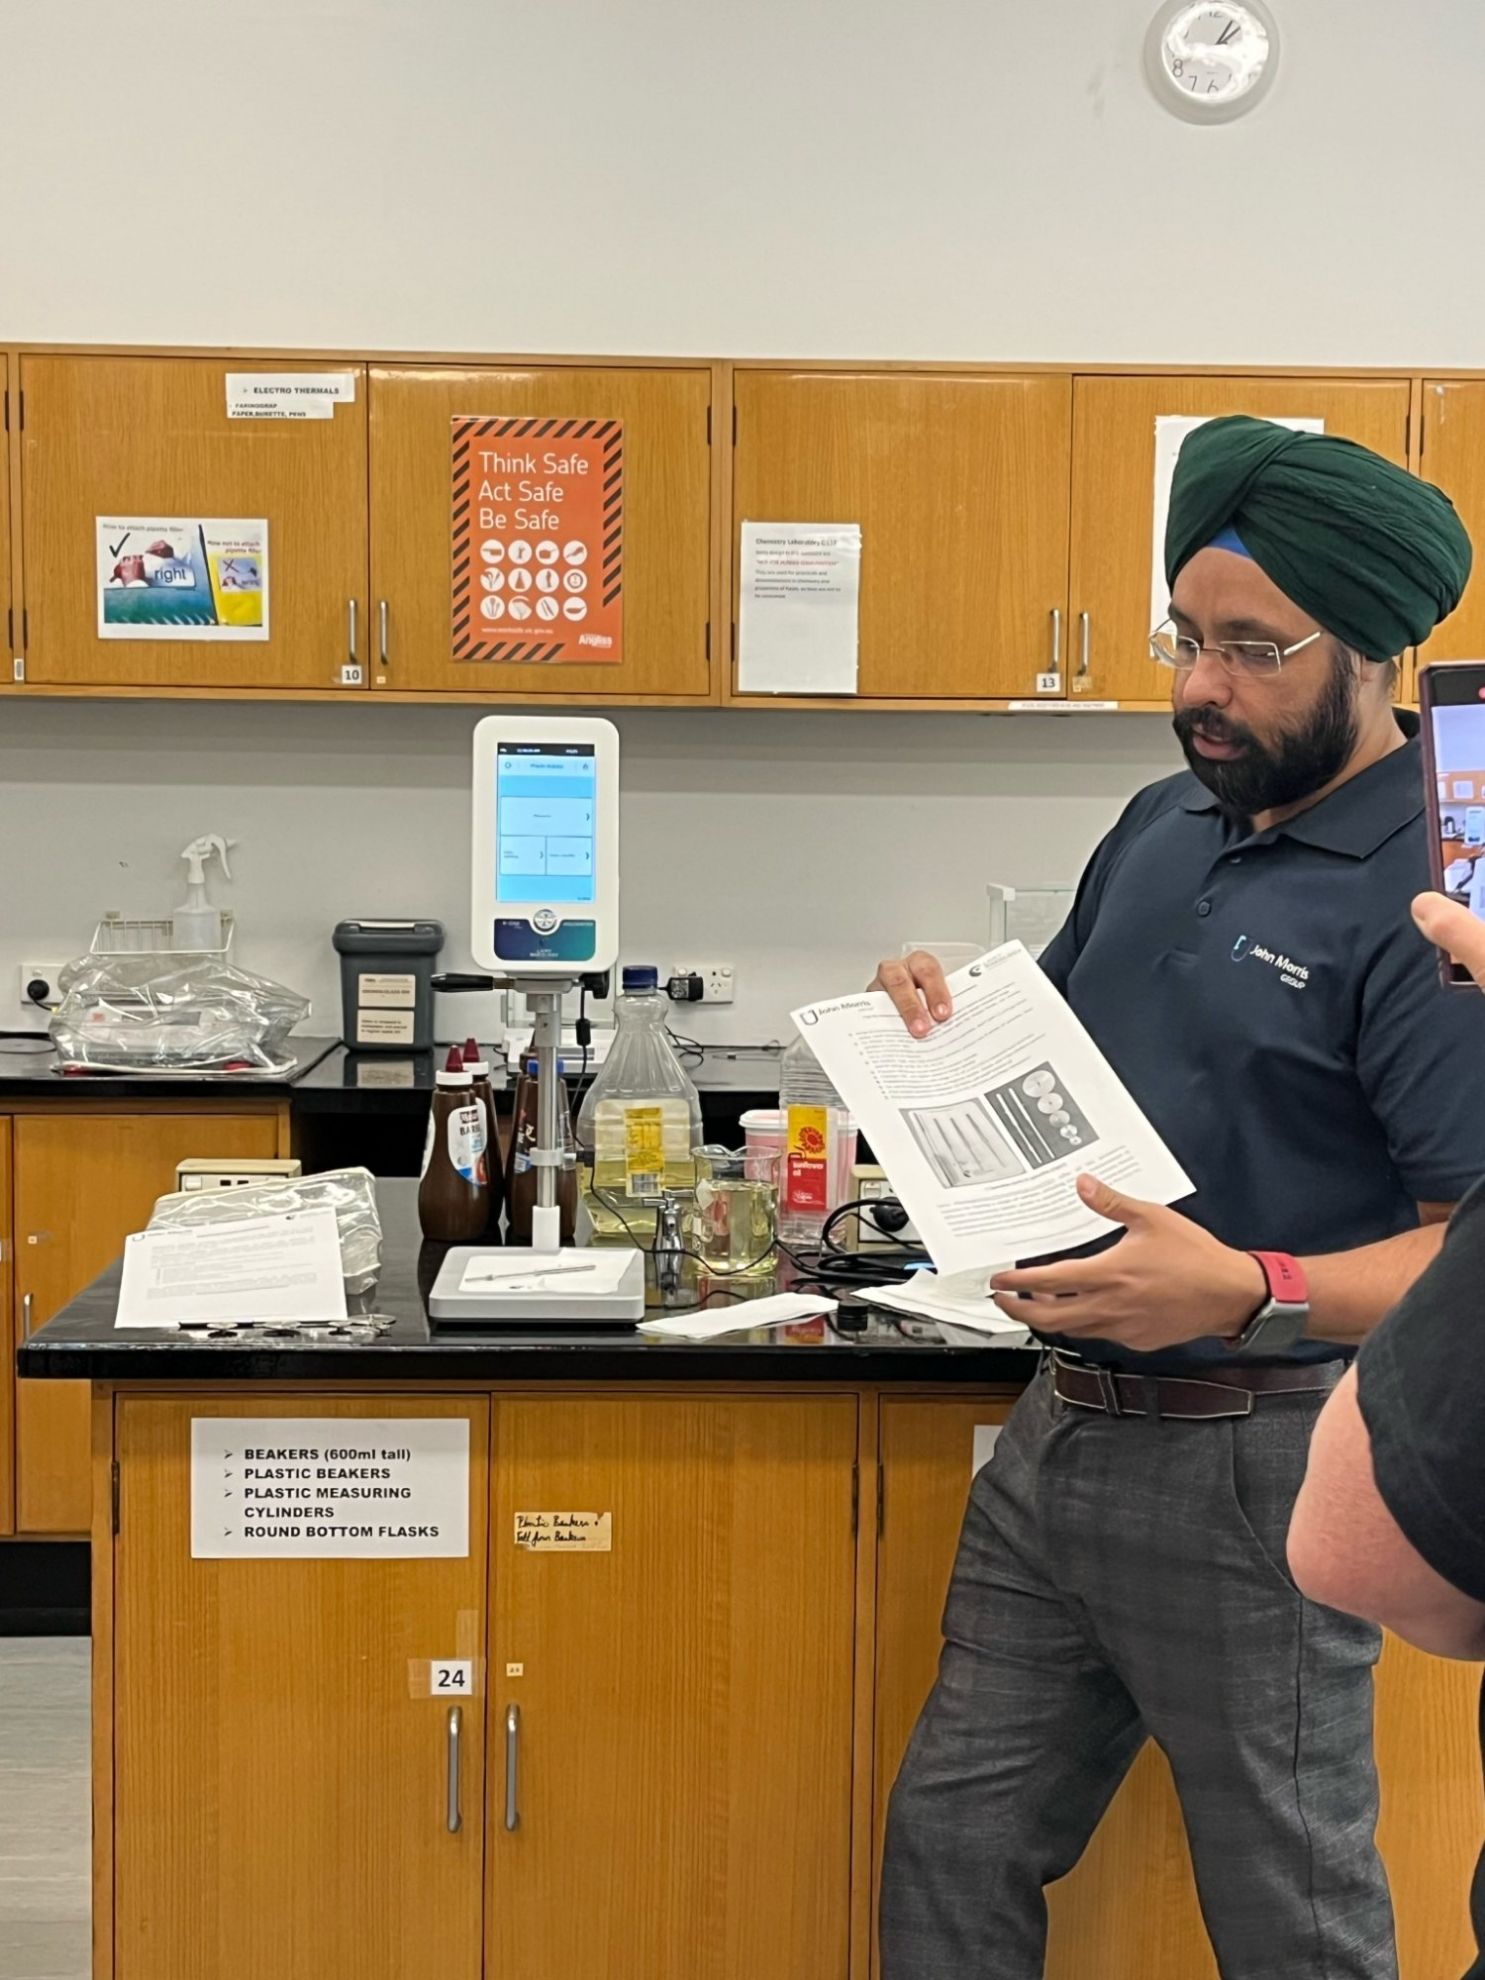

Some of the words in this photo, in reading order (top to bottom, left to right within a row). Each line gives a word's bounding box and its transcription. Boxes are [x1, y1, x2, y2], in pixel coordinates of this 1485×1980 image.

[1172, 59, 1184, 78] 8
[1189, 76, 1197, 92] 7
[478, 452, 536, 473] Think
[543, 452, 589, 474] Safe
[478, 480, 512, 501] Act
[519, 480, 564, 502] Safe
[479, 508, 507, 529] Be
[515, 508, 560, 530] Safe
[755, 538, 786, 546] Chemistry
[788, 539, 820, 547] Laboratory
[154, 566, 187, 583] right
[345, 669, 360, 680] 10
[1041, 677, 1055, 688] 13
[1249, 944, 1275, 964] John
[1274, 954, 1309, 980] Morris
[818, 1005, 840, 1015] John
[840, 1000, 872, 1009] Morris
[244, 1448, 319, 1460] BEAKERS
[324, 1448, 376, 1462] (600ml
[381, 1448, 411, 1462] tall)
[244, 1468, 311, 1479] PLASTIC
[316, 1468, 391, 1479] BEAKERS
[244, 1487, 311, 1499] PLASTIC
[316, 1487, 412, 1499] MEASURING
[244, 1507, 335, 1518] CYLINDERS
[244, 1526, 301, 1537] ROUND
[305, 1526, 373, 1537] BOTTOM
[378, 1526, 439, 1538] FLASKS
[438, 1669, 466, 1687] 24
